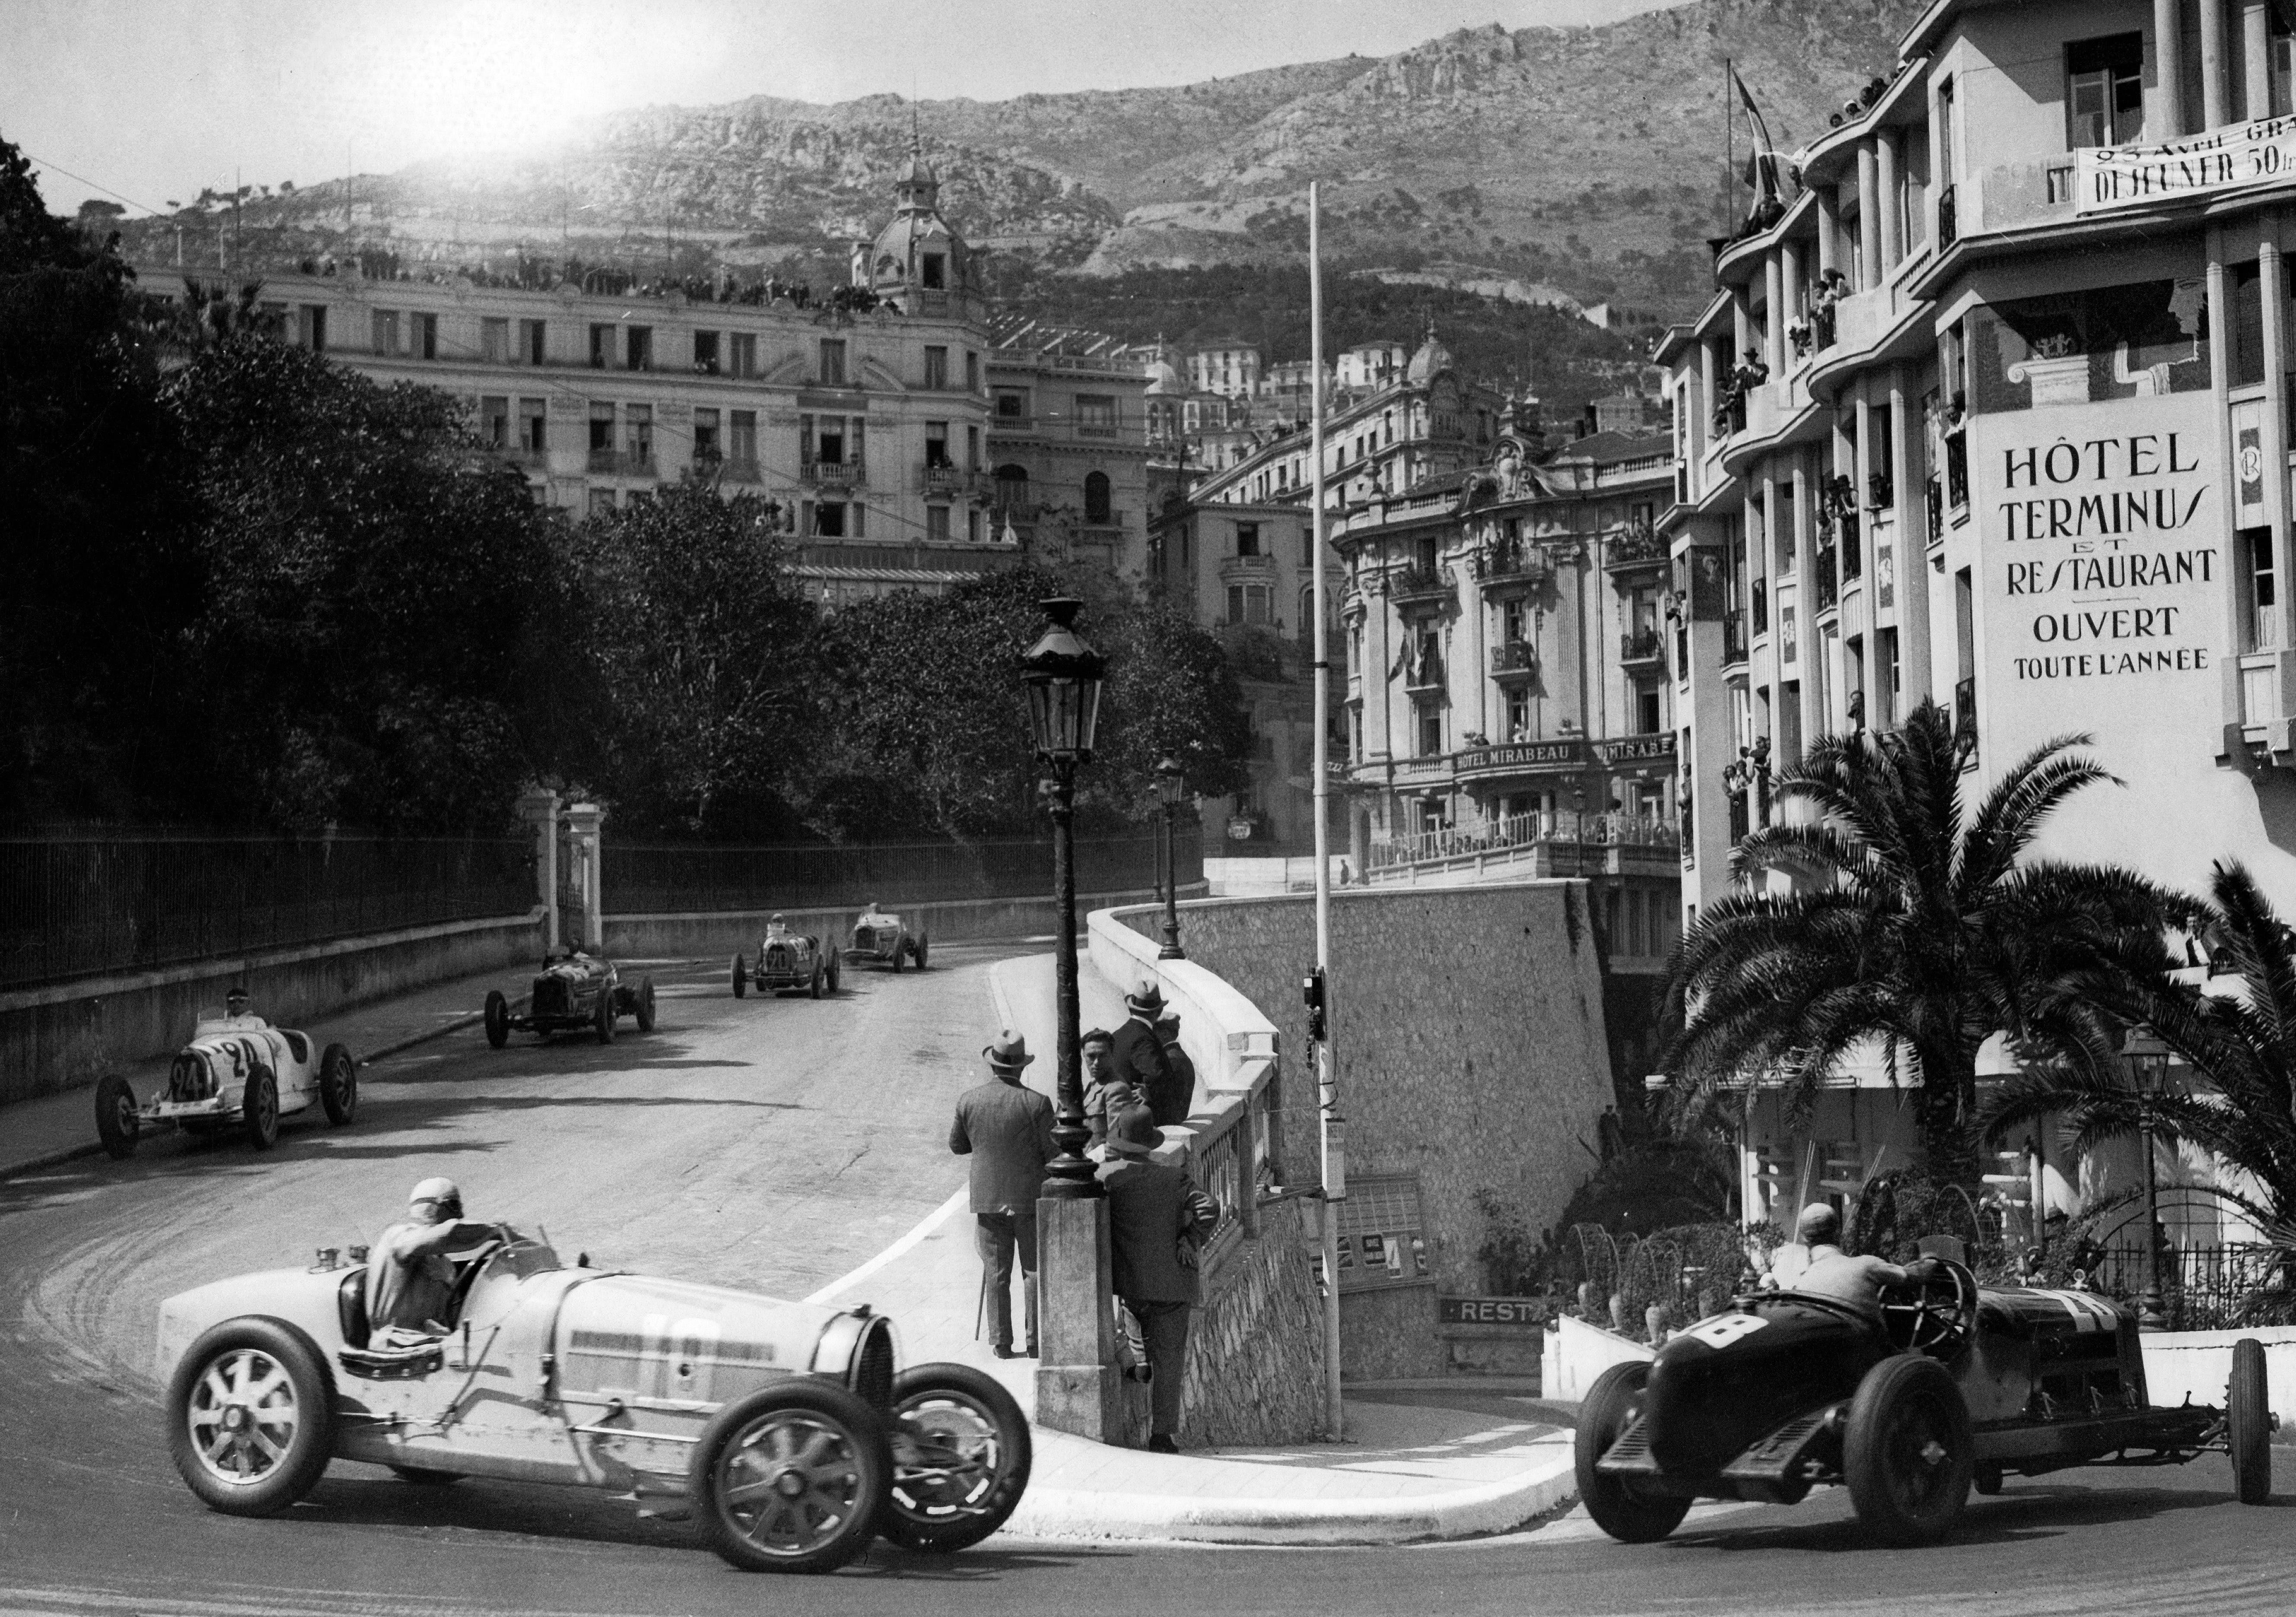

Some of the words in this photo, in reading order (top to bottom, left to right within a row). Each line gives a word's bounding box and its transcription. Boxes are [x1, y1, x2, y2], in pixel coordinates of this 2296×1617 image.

[2003, 432, 2199, 489] HÔTEL
[1999, 484, 2210, 542] TERMINUS
[2072, 538, 2128, 554] ET
[2007, 548, 2217, 596] RESTAURANT
[2033, 606, 2179, 643] OUVERT
[2013, 654, 2092, 680] TOUTE
[1489, 745, 1569, 764] MIRABEAU
